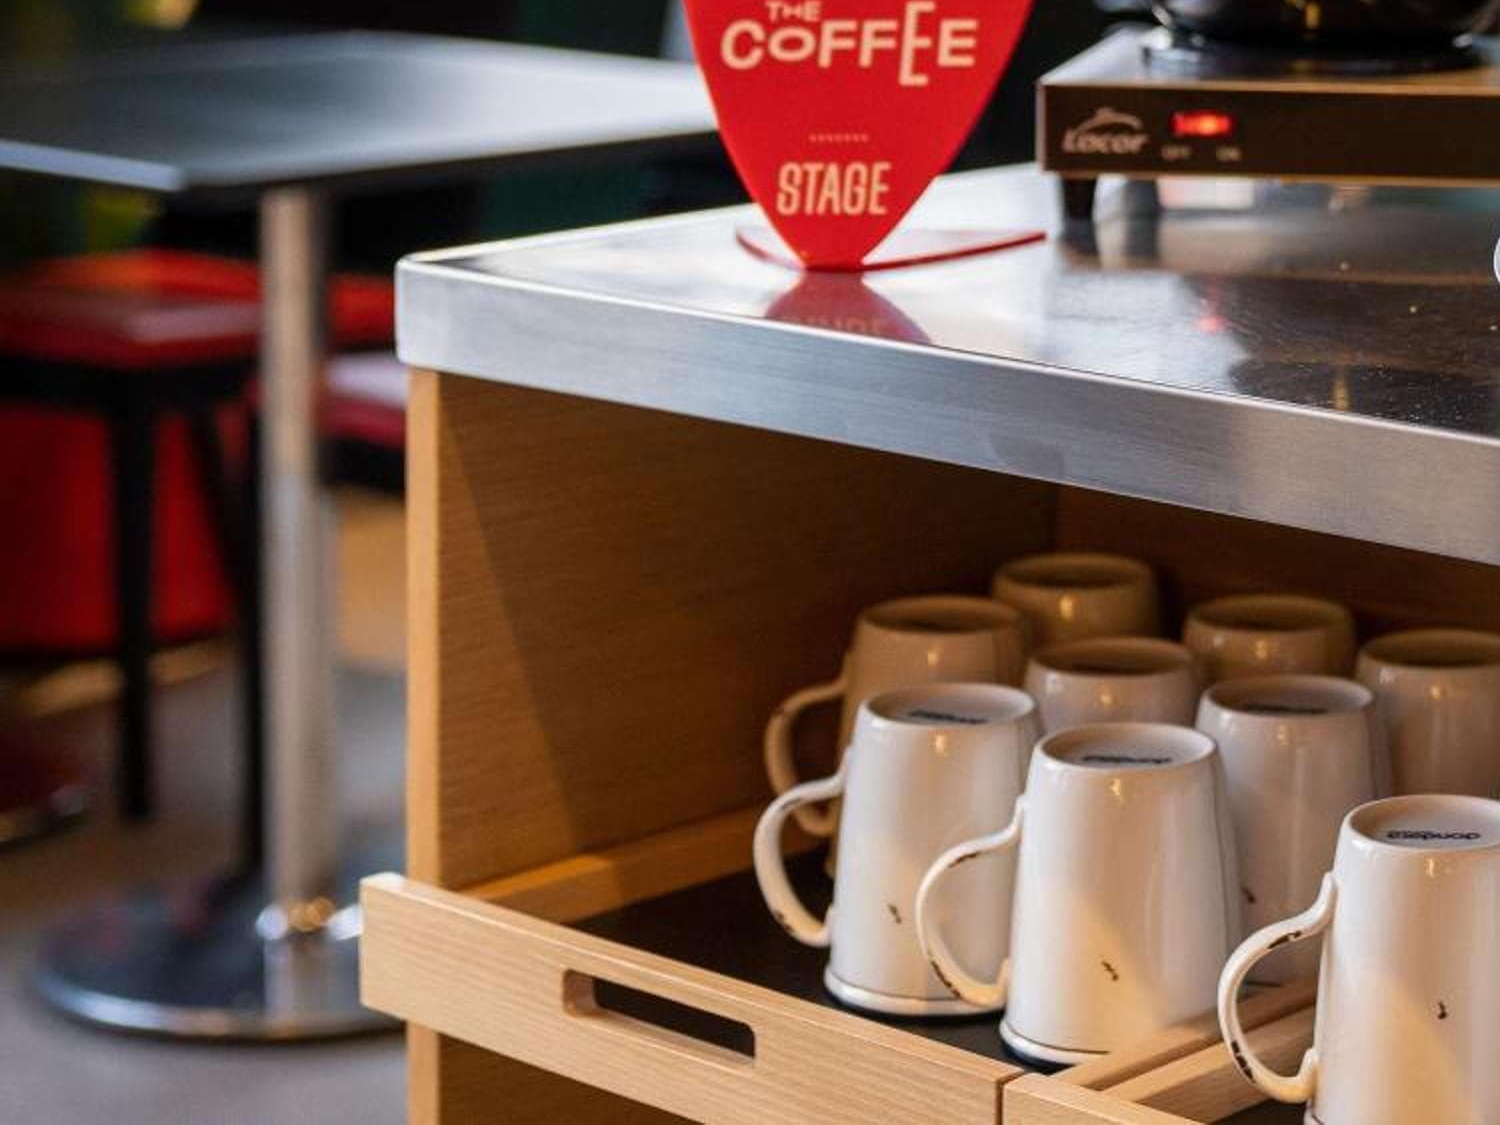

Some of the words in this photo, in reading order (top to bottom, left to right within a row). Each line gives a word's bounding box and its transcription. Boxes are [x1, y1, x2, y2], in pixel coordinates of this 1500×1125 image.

[765, 0, 822, 22] THE
[720, 0, 979, 87] COFFEE
[776, 161, 891, 216] STAGE
